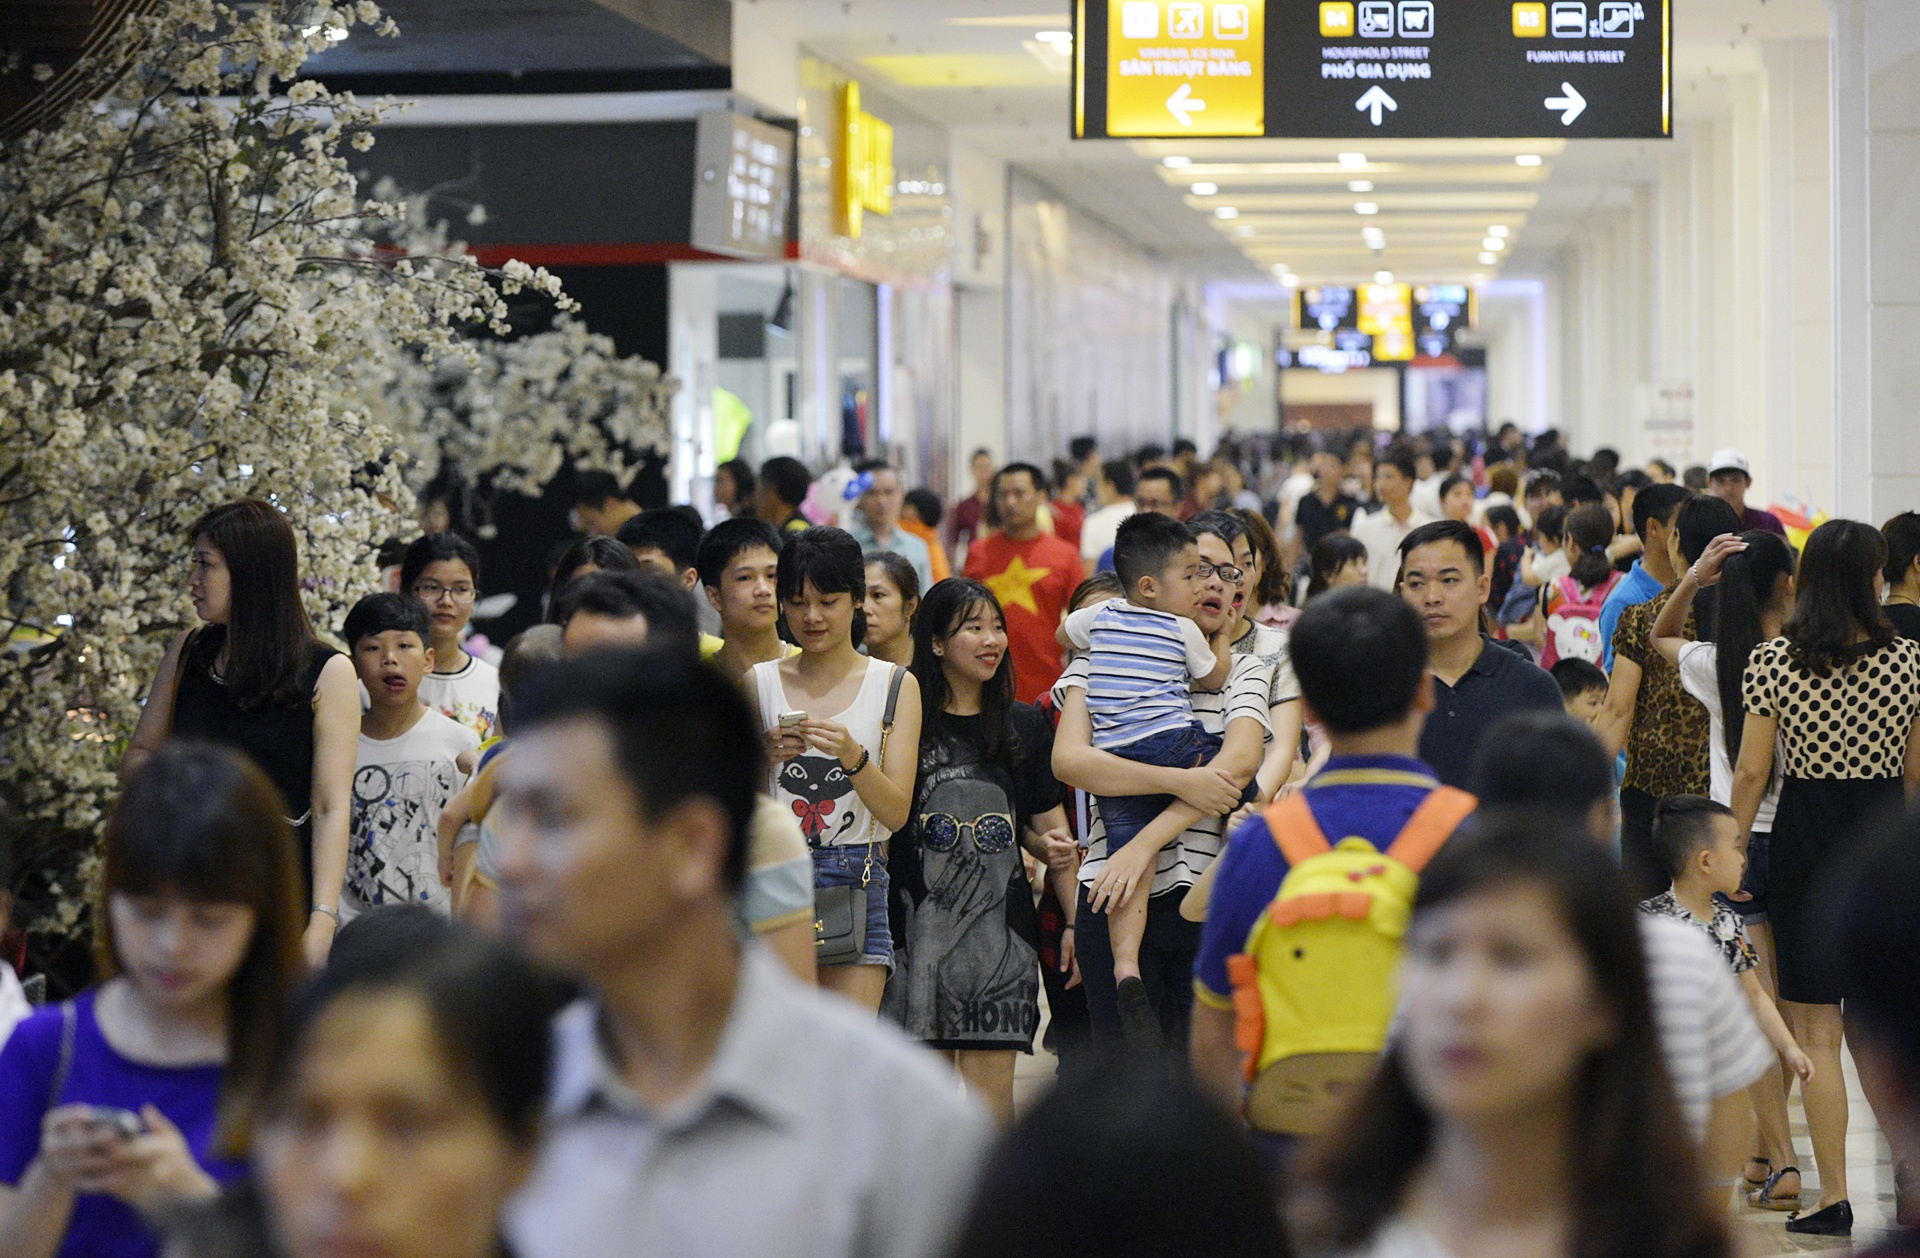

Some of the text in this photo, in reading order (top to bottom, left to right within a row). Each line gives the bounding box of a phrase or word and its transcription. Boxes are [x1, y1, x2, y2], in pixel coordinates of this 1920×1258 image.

[1321, 46, 1430, 60] HOUSEHOLD STREET
[1526, 50, 1626, 63] FURNITURE STREET
[1321, 60, 1431, 82] PHỐ GIA DỤNG
